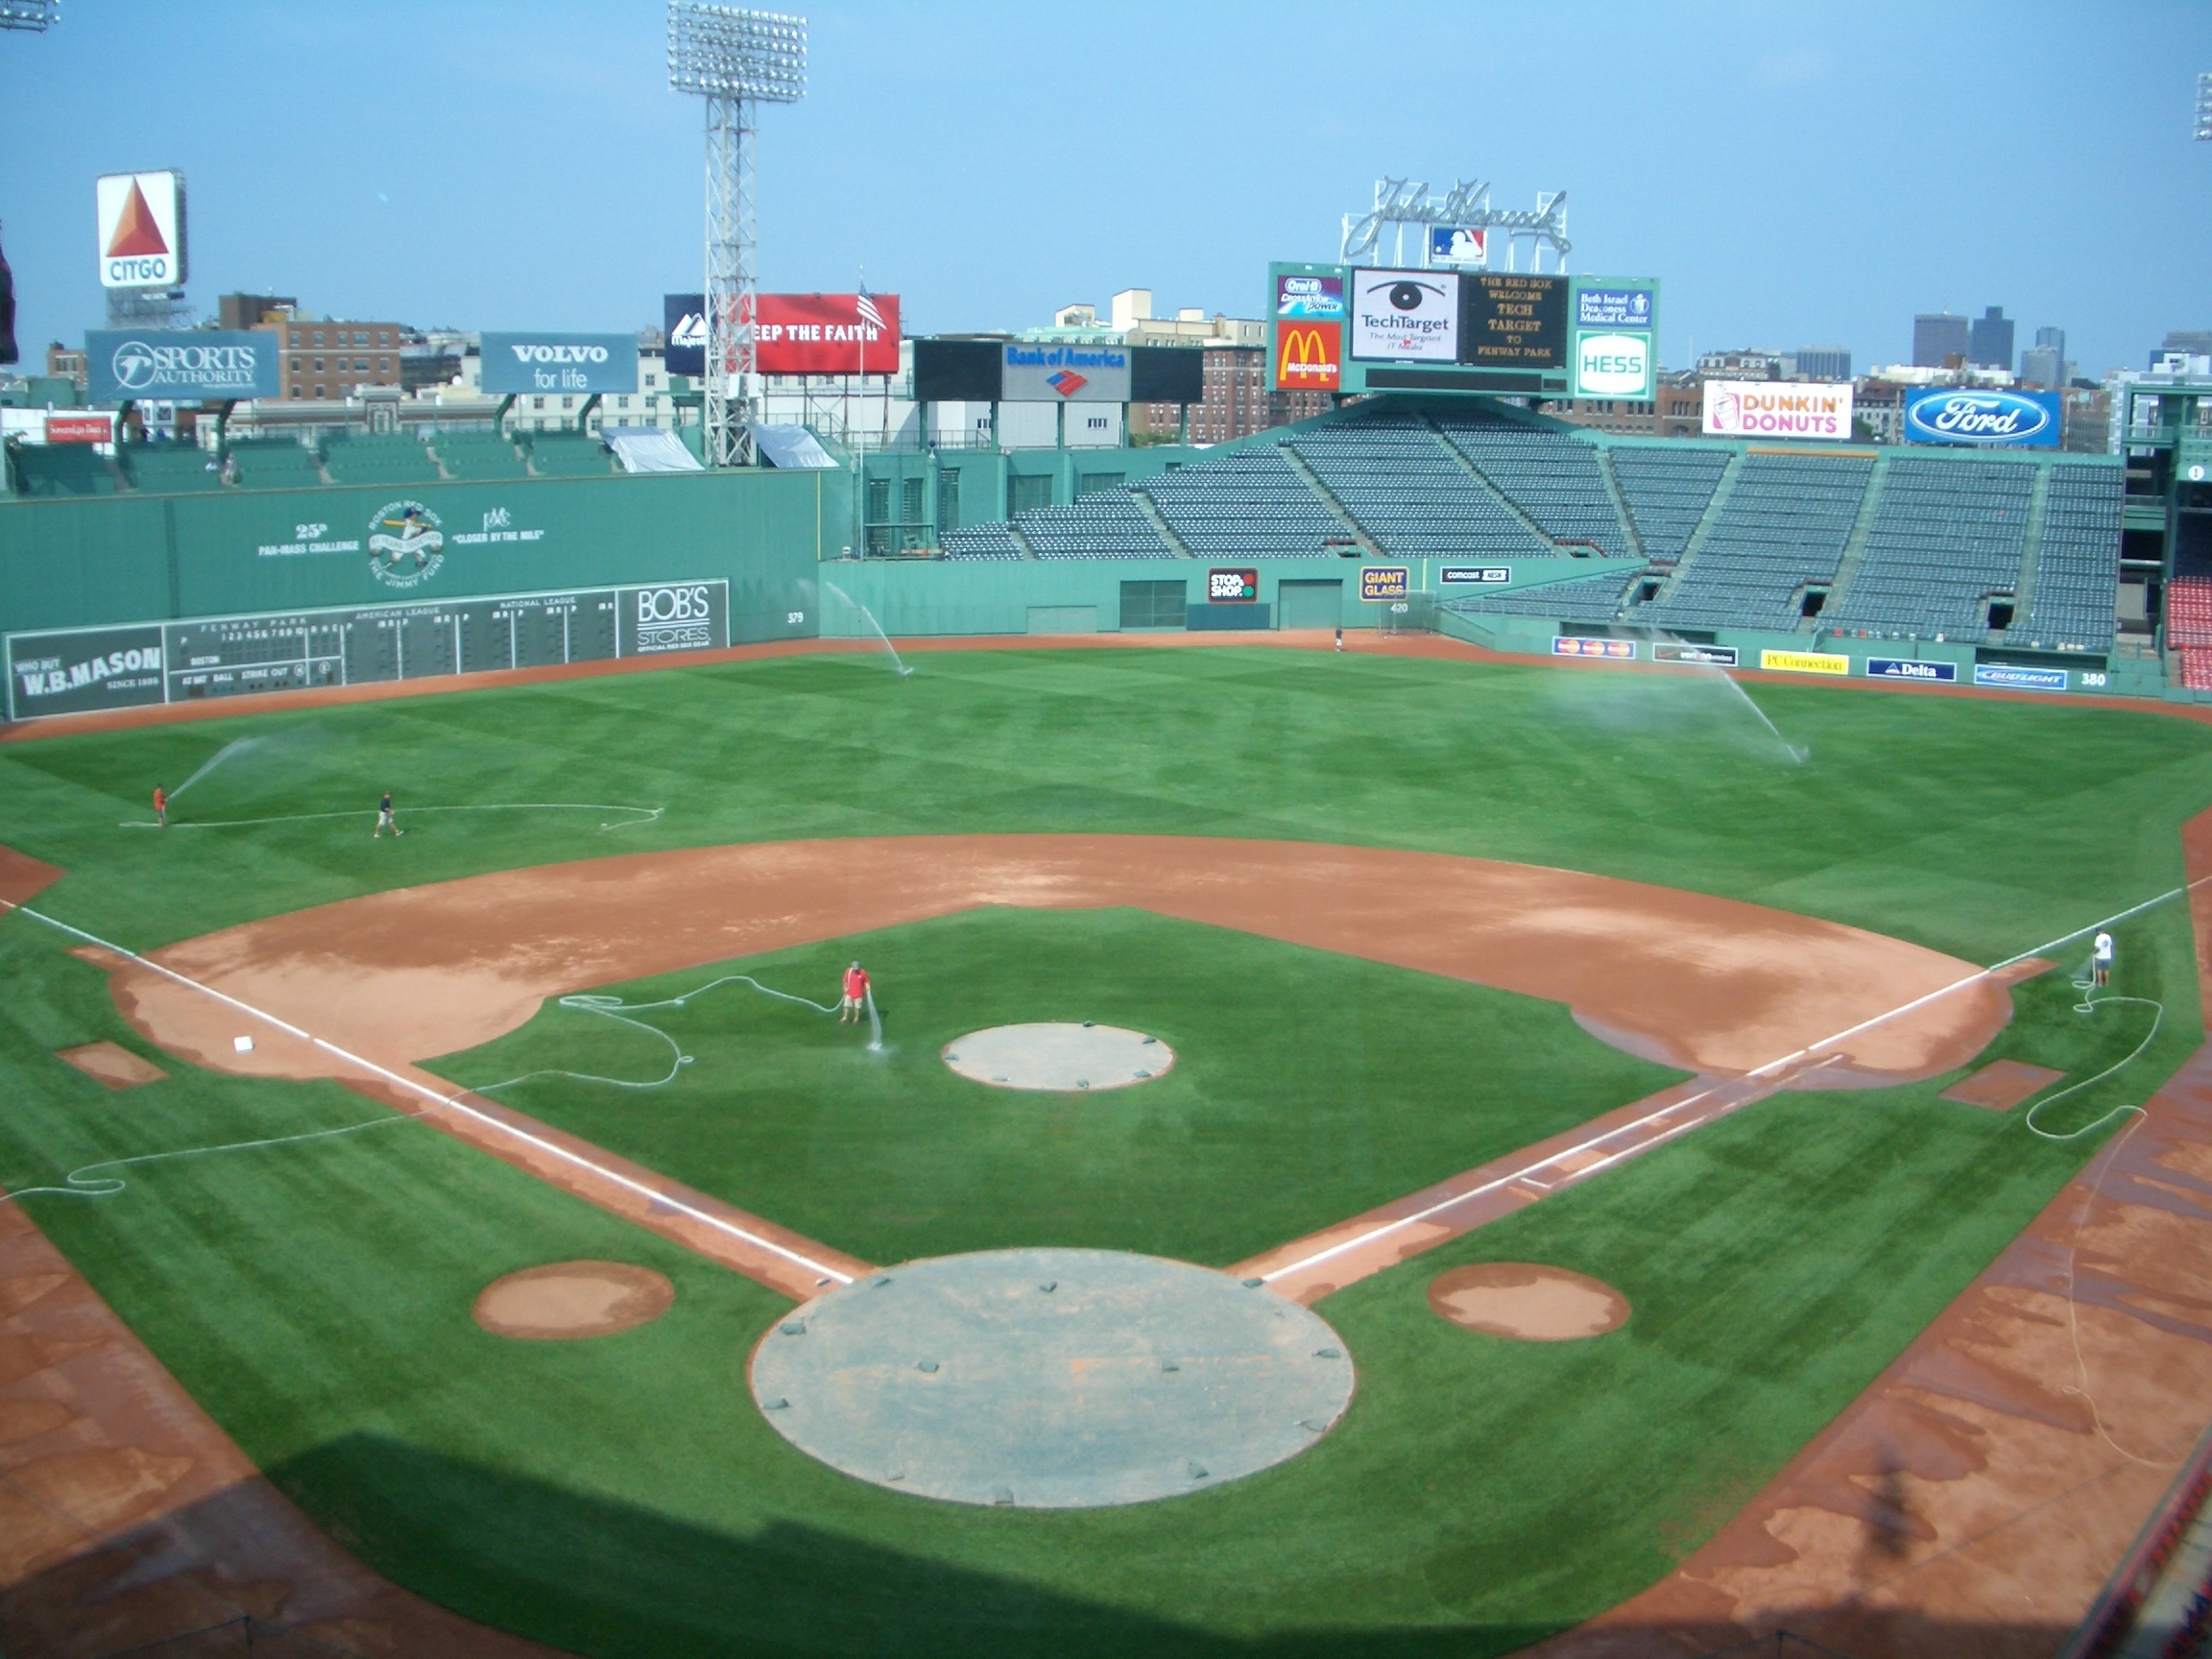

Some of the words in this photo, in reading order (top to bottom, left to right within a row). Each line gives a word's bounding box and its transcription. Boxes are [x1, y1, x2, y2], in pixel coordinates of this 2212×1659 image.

[1344, 176, 1436, 257] John
[1437, 178, 1573, 254] Hancock
[110, 257, 166, 281] CITGO
[1479, 277, 1502, 287] THE
[1504, 278, 1527, 288] RED
[1529, 278, 1552, 289] SOX
[1489, 290, 1542, 301] WELCOME
[1580, 293, 1602, 303] Beth
[1603, 294, 1628, 304] Israel
[1497, 303, 1533, 315] TECH
[1361, 315, 1449, 333] TechTarget
[1580, 312, 1616, 323] Medical
[1618, 313, 1647, 324] Center
[1488, 319, 1542, 331] TARGET
[754, 325, 783, 341] EEP
[786, 325, 821, 341] THE
[825, 325, 878, 341] FAITH
[1386, 332, 1407, 341] Most
[1506, 335, 1523, 344] TO
[512, 345, 609, 363] VOLVO
[1007, 347, 1046, 366] Bank
[1047, 348, 1064, 366] of
[1066, 348, 1125, 367] America
[1478, 346, 1520, 356] FENWAY
[1524, 347, 1551, 357] PARK
[154, 347, 255, 370] SPORTS
[1584, 355, 1642, 373] HESS
[1286, 362, 1337, 373] McDonald's
[156, 371, 253, 384] AUTHORITY
[534, 368, 557, 389] for
[563, 368, 588, 389] life
[1743, 394, 1843, 413] DUNKIN'
[1936, 397, 2021, 432] Ford
[1743, 414, 1838, 434] DONUTS
[369, 501, 401, 530] BOSTON
[423, 509, 442, 526] SOX
[258, 543, 306, 556] PAN-MASS
[309, 541, 359, 552] CHALLENGE
[385, 577, 418, 588] JIMMY
[422, 554, 444, 580] FUND
[1364, 571, 1404, 584] GIANT
[1447, 570, 1479, 579] comcast
[1211, 574, 1240, 586] STOP
[1211, 586, 1240, 596] SHOP
[1364, 585, 1404, 595] GLASS
[500, 600, 541, 609] NATIONAL
[543, 596, 576, 605] LEAGUE
[638, 586, 709, 622] BOB'S
[1390, 603, 1408, 613] 420
[355, 610, 401, 619] AMERICAN
[406, 607, 440, 616] LEAGUE
[787, 612, 804, 623] 379
[201, 620, 259, 633] FENWAY
[270, 617, 306, 627] PARK
[637, 627, 709, 645] STORES
[190, 656, 220, 666] BOSTON
[1681, 651, 1712, 661] verion
[1767, 654, 1783, 665] PC
[1784, 656, 1842, 671] Connection
[14, 661, 39, 672] WHO
[40, 659, 60, 670] BUT
[23, 647, 161, 695] W.B.MASON
[1901, 663, 1936, 677] Delta
[182, 676, 192, 685] AT
[193, 675, 207, 685] BAT
[213, 673, 233, 683] BALL
[242, 669, 268, 679] STRIKE
[271, 667, 287, 676] OUT
[1990, 672, 2020, 681] BUD
[2020, 673, 2062, 683] LIGHT
[2081, 673, 2105, 685] 380
[107, 679, 135, 689] SINCE
